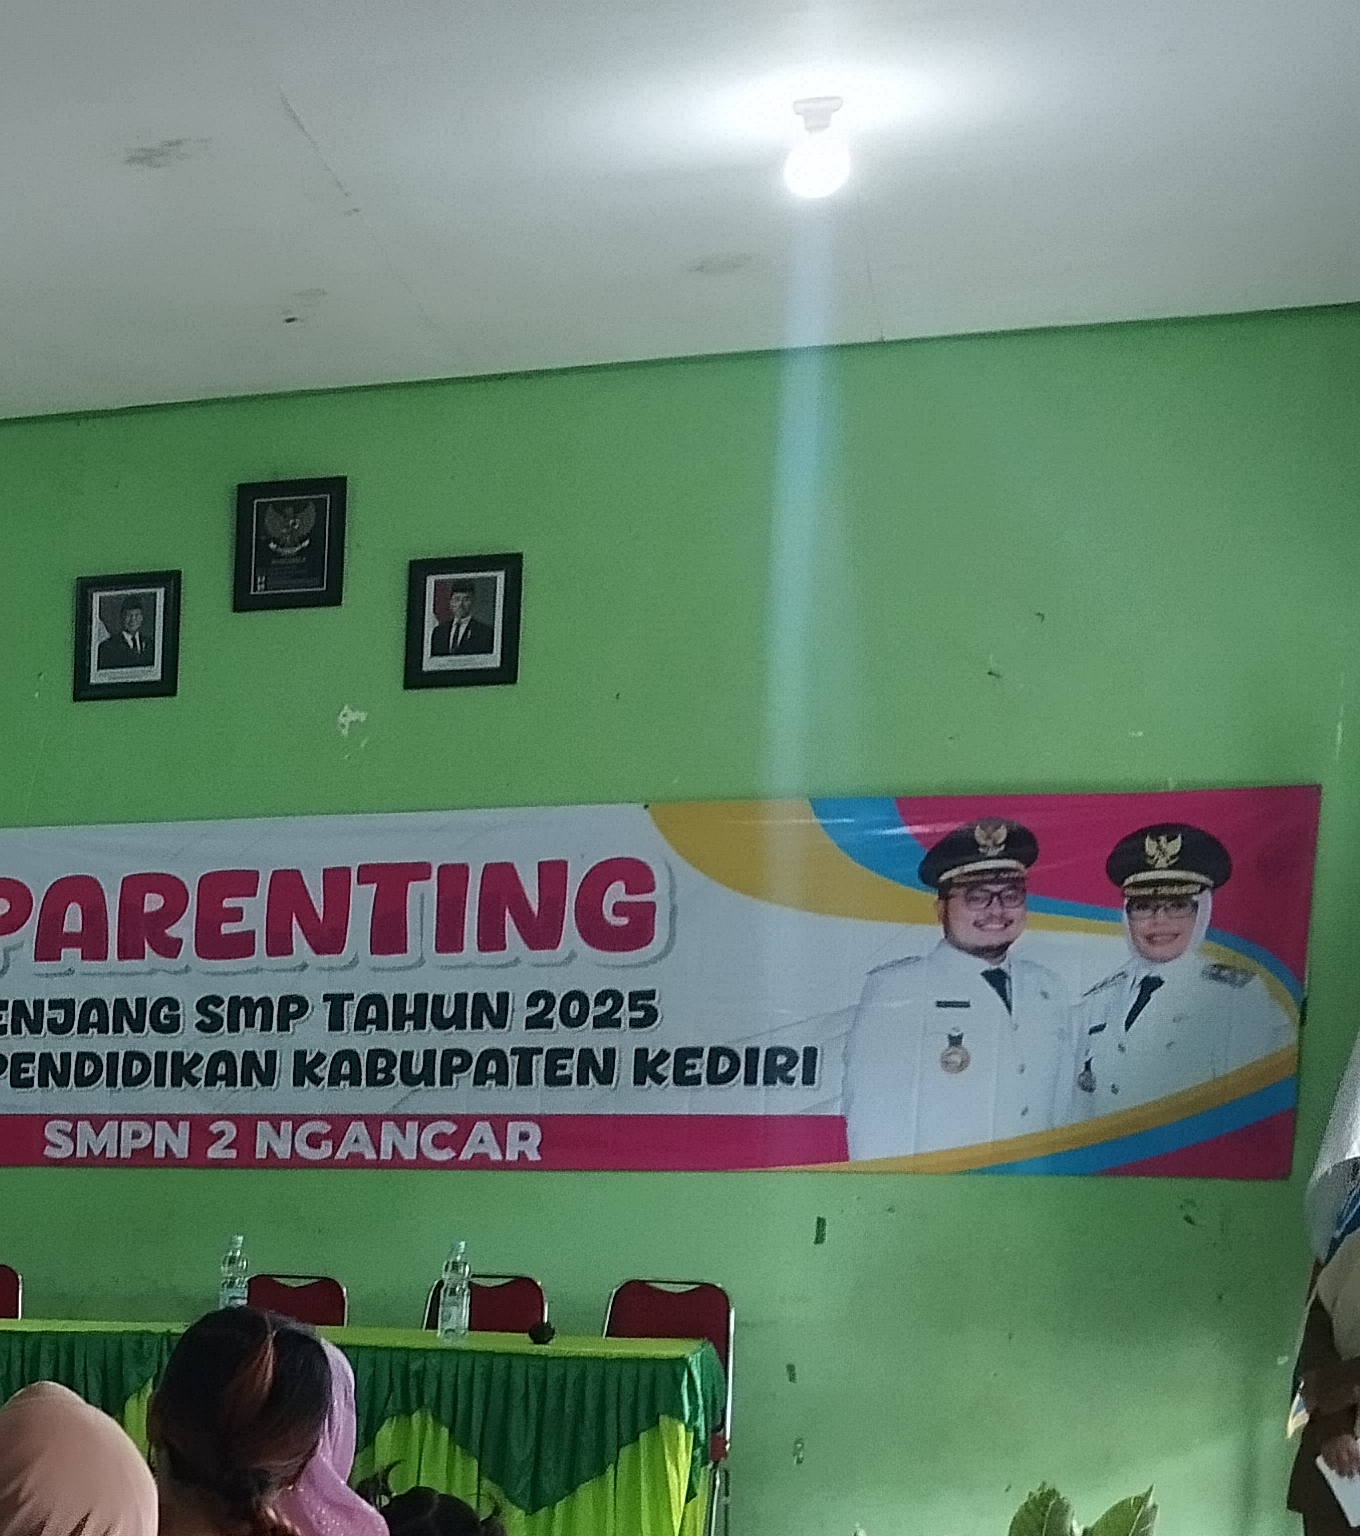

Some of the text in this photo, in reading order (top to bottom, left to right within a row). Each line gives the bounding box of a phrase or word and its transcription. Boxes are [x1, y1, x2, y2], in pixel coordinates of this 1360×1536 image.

[321, 990, 511, 1033] TAHUN
[523, 988, 661, 1032] 2025
[291, 1045, 618, 1089] KABUPATEN
[631, 1045, 820, 1088] KEDIRI
[43, 1120, 543, 1162] SMPN 2 NGANCAR
